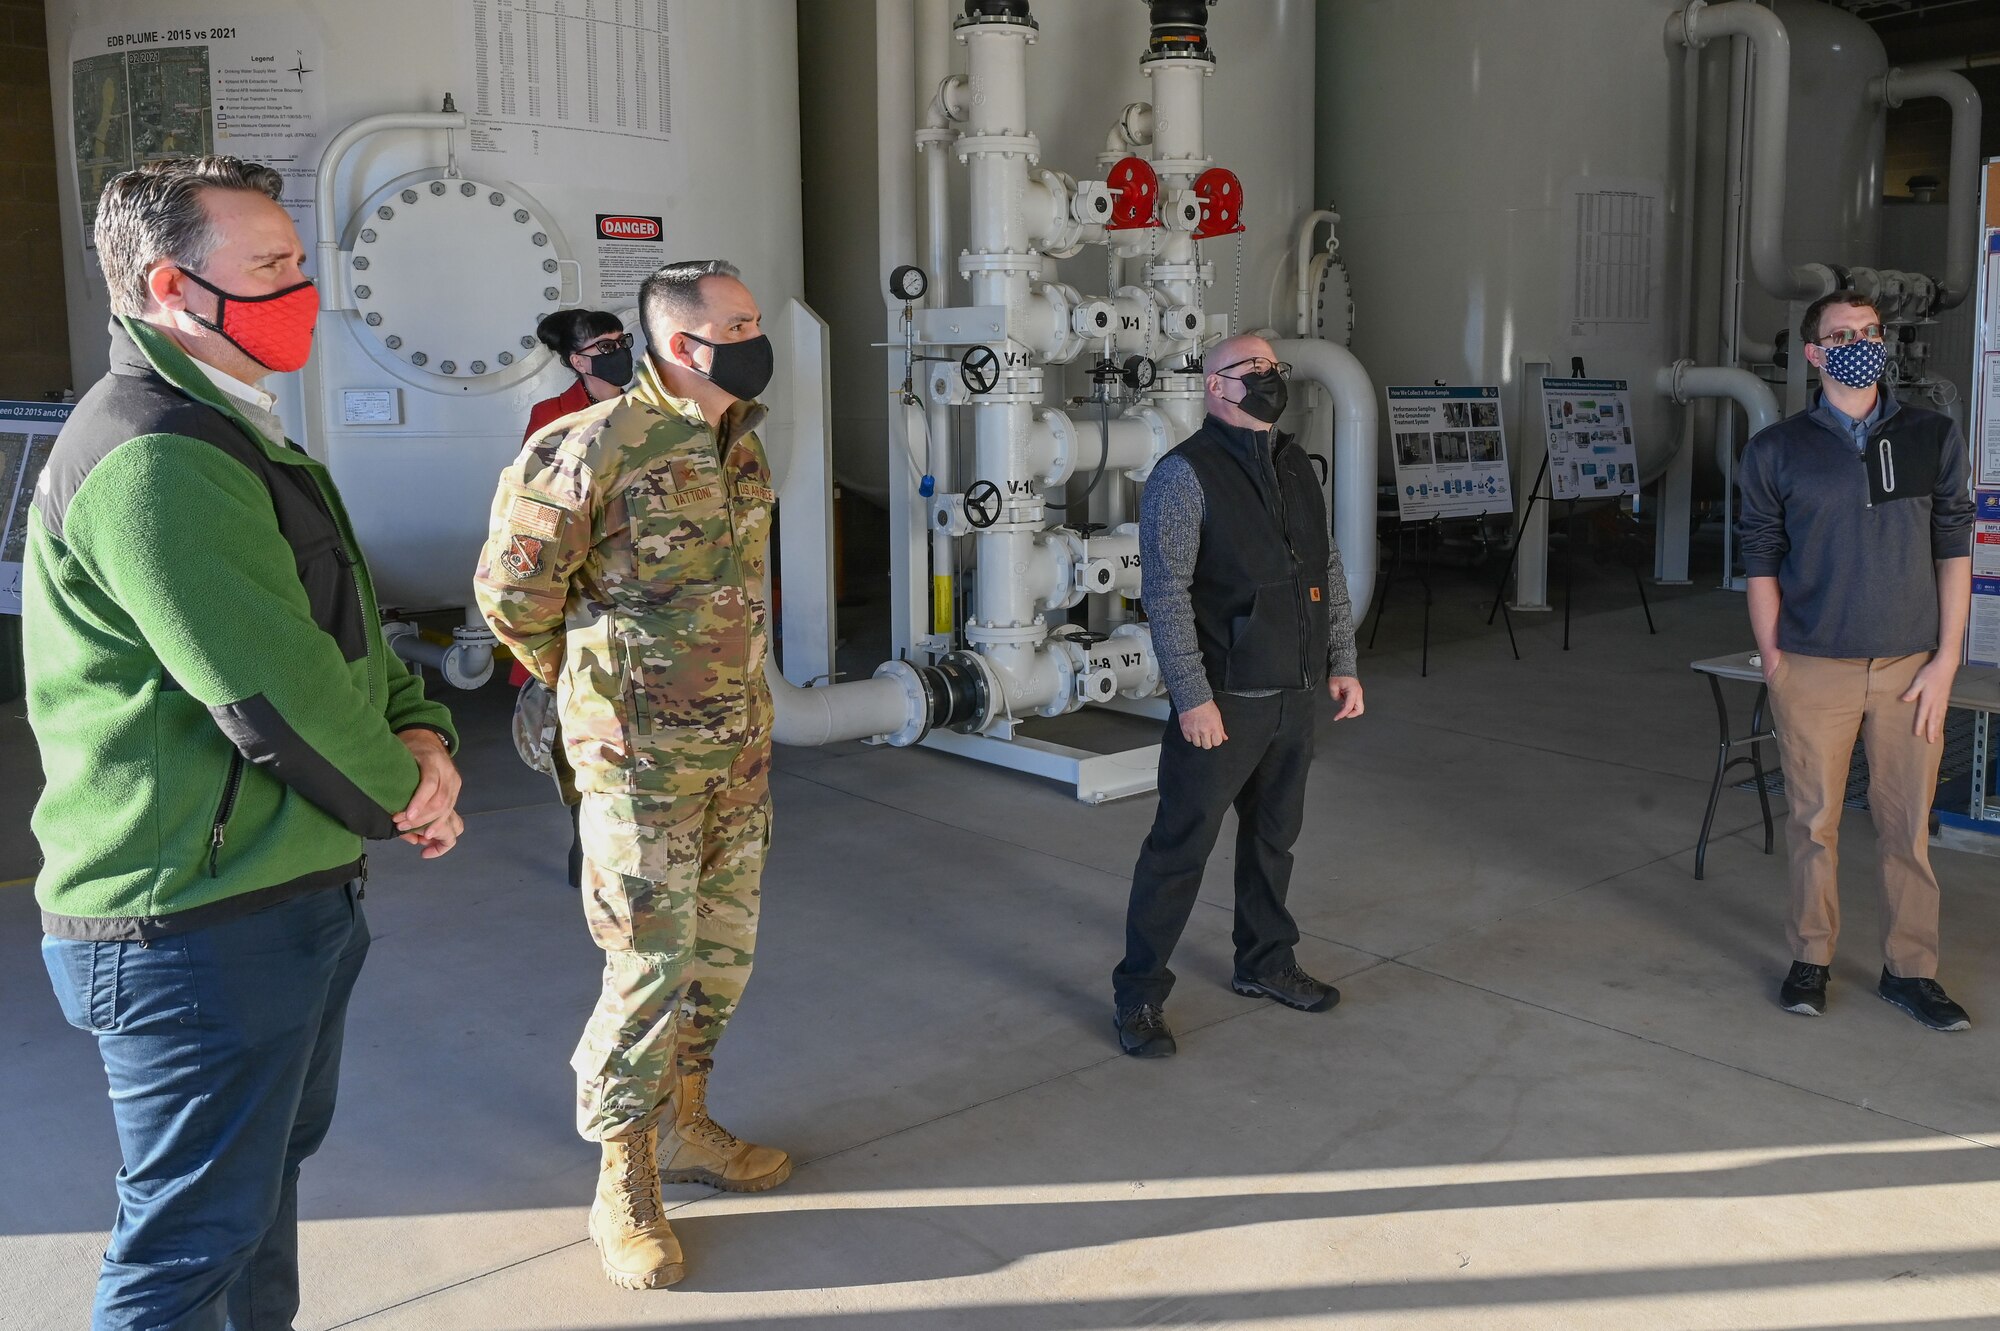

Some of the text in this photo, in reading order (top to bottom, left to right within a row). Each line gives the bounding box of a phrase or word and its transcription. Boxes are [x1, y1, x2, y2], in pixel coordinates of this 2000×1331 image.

[108, 36, 124, 47] EDB
[126, 32, 158, 44] PLUME
[167, 29, 191, 41] 2015
[194, 31, 207, 39] vs
[210, 28, 236, 39] 2021
[128, 51, 160, 64] Q2 2021
[605, 221, 655, 235] DANGER
[1121, 316, 1139, 330] V-1
[13, 408, 24, 416] Q2
[24, 408, 42, 416] 2015
[58, 410, 68, 418] Q4
[673, 487, 712, 506] VATTIONI
[1121, 554, 1140, 568] V-3
[1121, 653, 1141, 667] V-7
